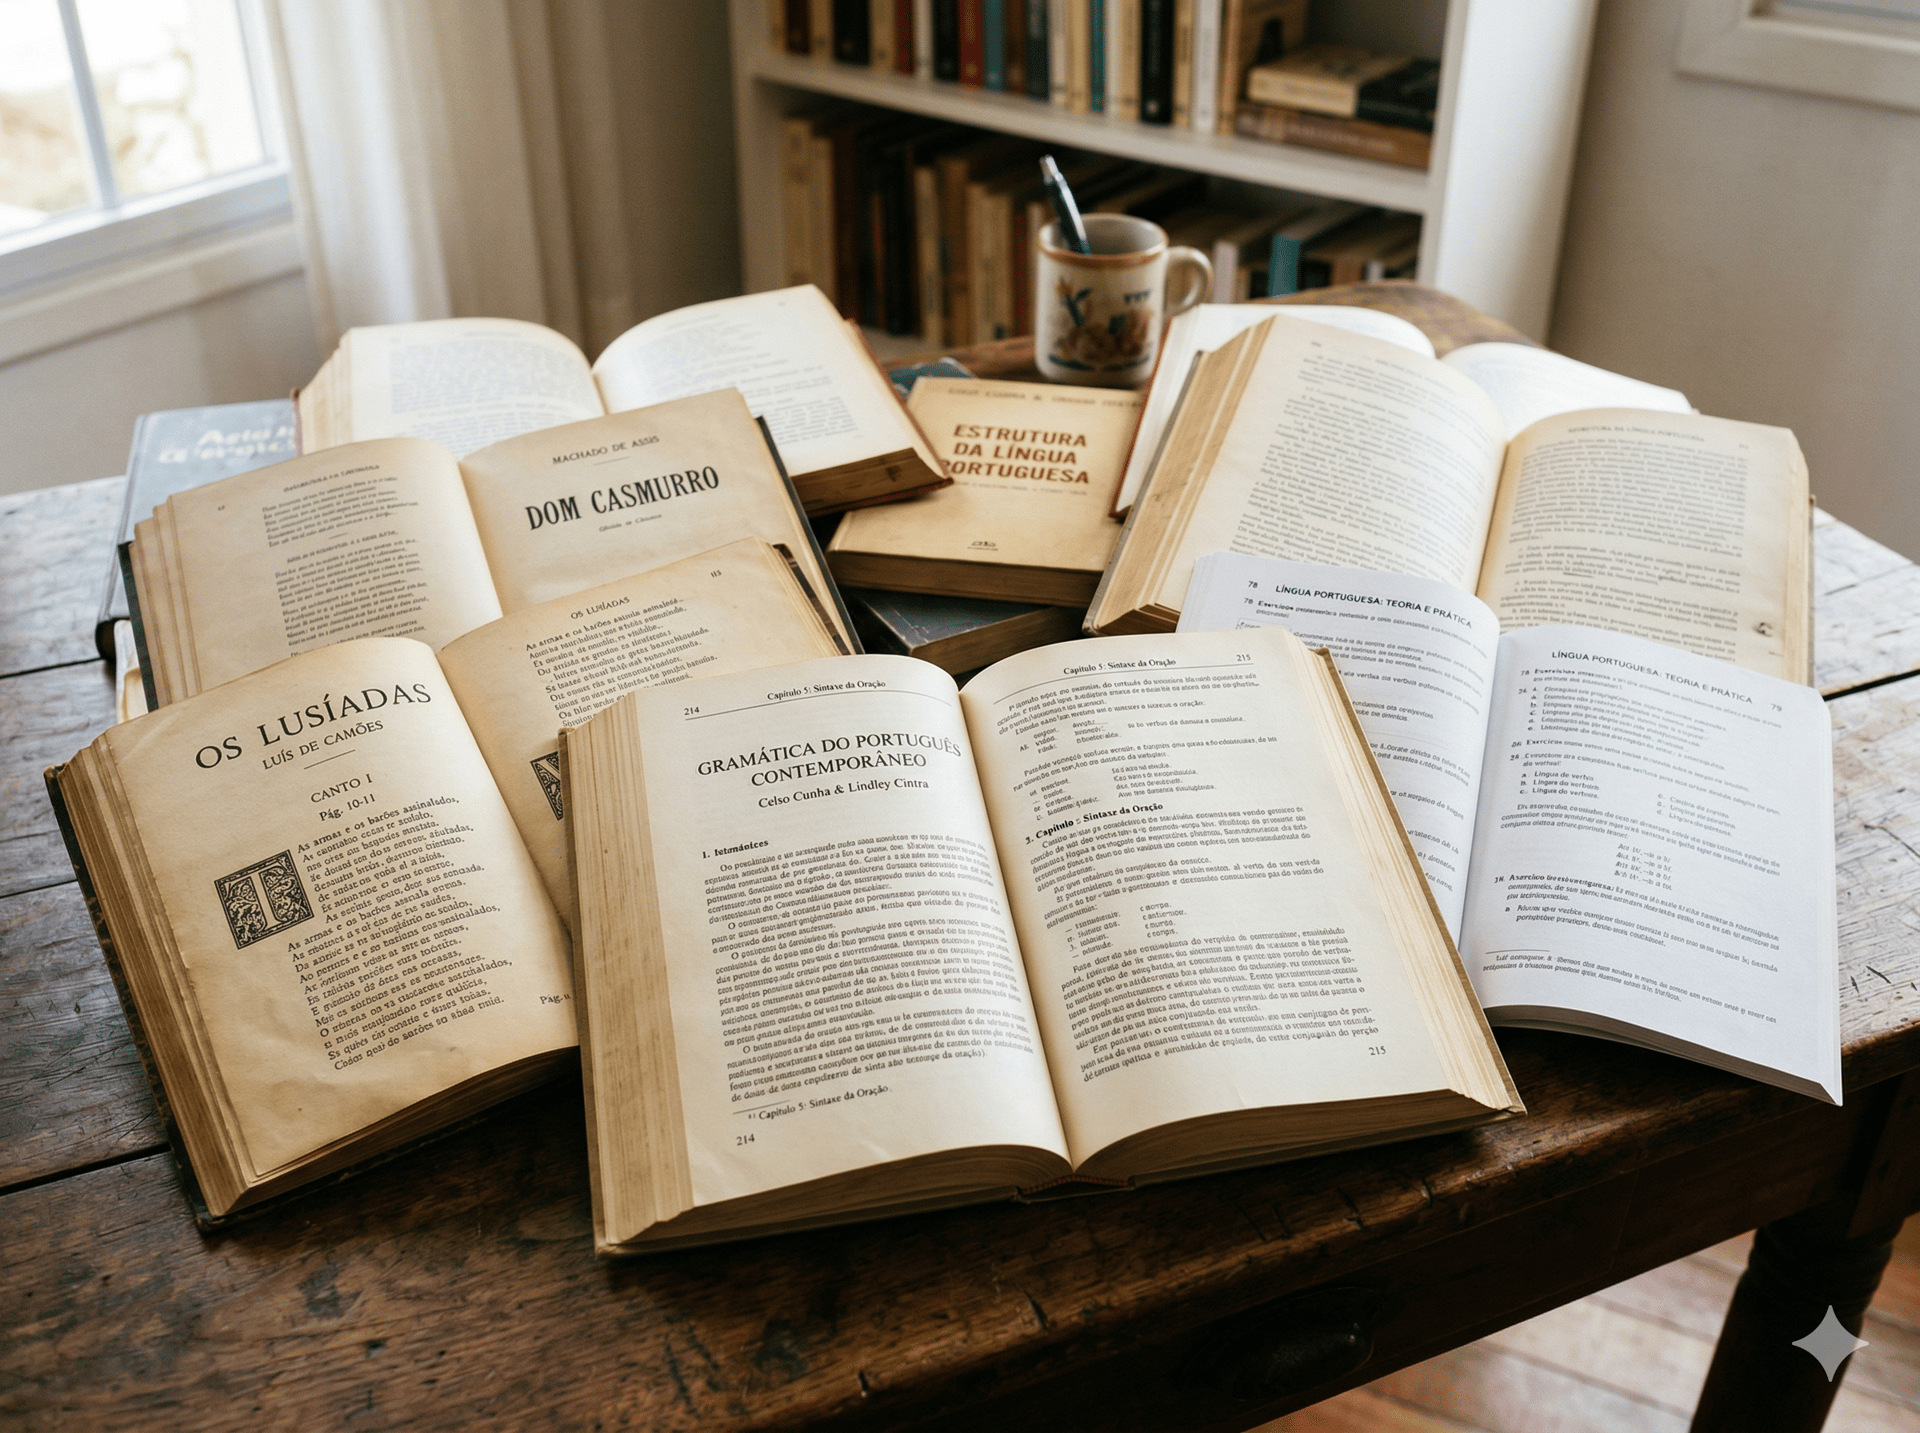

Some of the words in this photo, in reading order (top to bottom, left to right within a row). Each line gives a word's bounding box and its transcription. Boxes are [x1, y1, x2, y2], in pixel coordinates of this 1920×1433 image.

[953, 424, 1087, 447] ESTRUTURA
[552, 445, 609, 465] MACHADO
[612, 442, 627, 452] DE
[953, 442, 982, 457] DA
[993, 442, 1077, 465] LÍNGUA
[525, 496, 582, 530] DOM
[590, 466, 719, 514] CASMURRO
[1248, 580, 1259, 589] 78
[1275, 584, 1312, 597] LÍNGUA
[1313, 590, 1384, 606] PORTUGUESA:
[1386, 599, 1422, 612] TEORIA
[1424, 605, 1431, 613] E
[1433, 606, 1473, 629] PRÁTICA
[1138, 658, 1147, 667] da
[1236, 654, 1252, 662] 215
[845, 681, 855, 690] da
[1552, 650, 1590, 661] LÍNGUA
[1664, 673, 1700, 689] TEORIA
[1710, 684, 1753, 704] PRÁTICA
[1770, 704, 1783, 712] 79
[684, 706, 700, 716] 214
[195, 735, 243, 769] OS
[257, 683, 432, 746] LUSÍADAS
[262, 750, 294, 770] LUÍS
[299, 741, 320, 755] DE
[323, 720, 383, 746] CAMÕES
[697, 742, 816, 776] GRAMÁTICA
[821, 737, 850, 753] DO
[855, 732, 962, 758] PORTUGUÊS
[751, 750, 927, 787] CONTEMPORÂNEO
[310, 778, 361, 803] CANTO
[366, 774, 373, 783] I
[758, 791, 790, 809] Celso
[793, 786, 831, 802] Cunha
[834, 784, 844, 794] &
[848, 778, 892, 793] Lindley
[894, 778, 929, 789] Cintra
[319, 807, 344, 821] Pág.
[346, 793, 376, 811] 10-11
[1035, 820, 1075, 839] Capítulo
[1119, 807, 1130, 815] da
[1132, 802, 1164, 814] Oração
[1368, 1045, 1387, 1057] 215
[844, 1092, 854, 1100] da
[857, 1085, 889, 1098] Oração
[736, 1134, 755, 1146] 214
